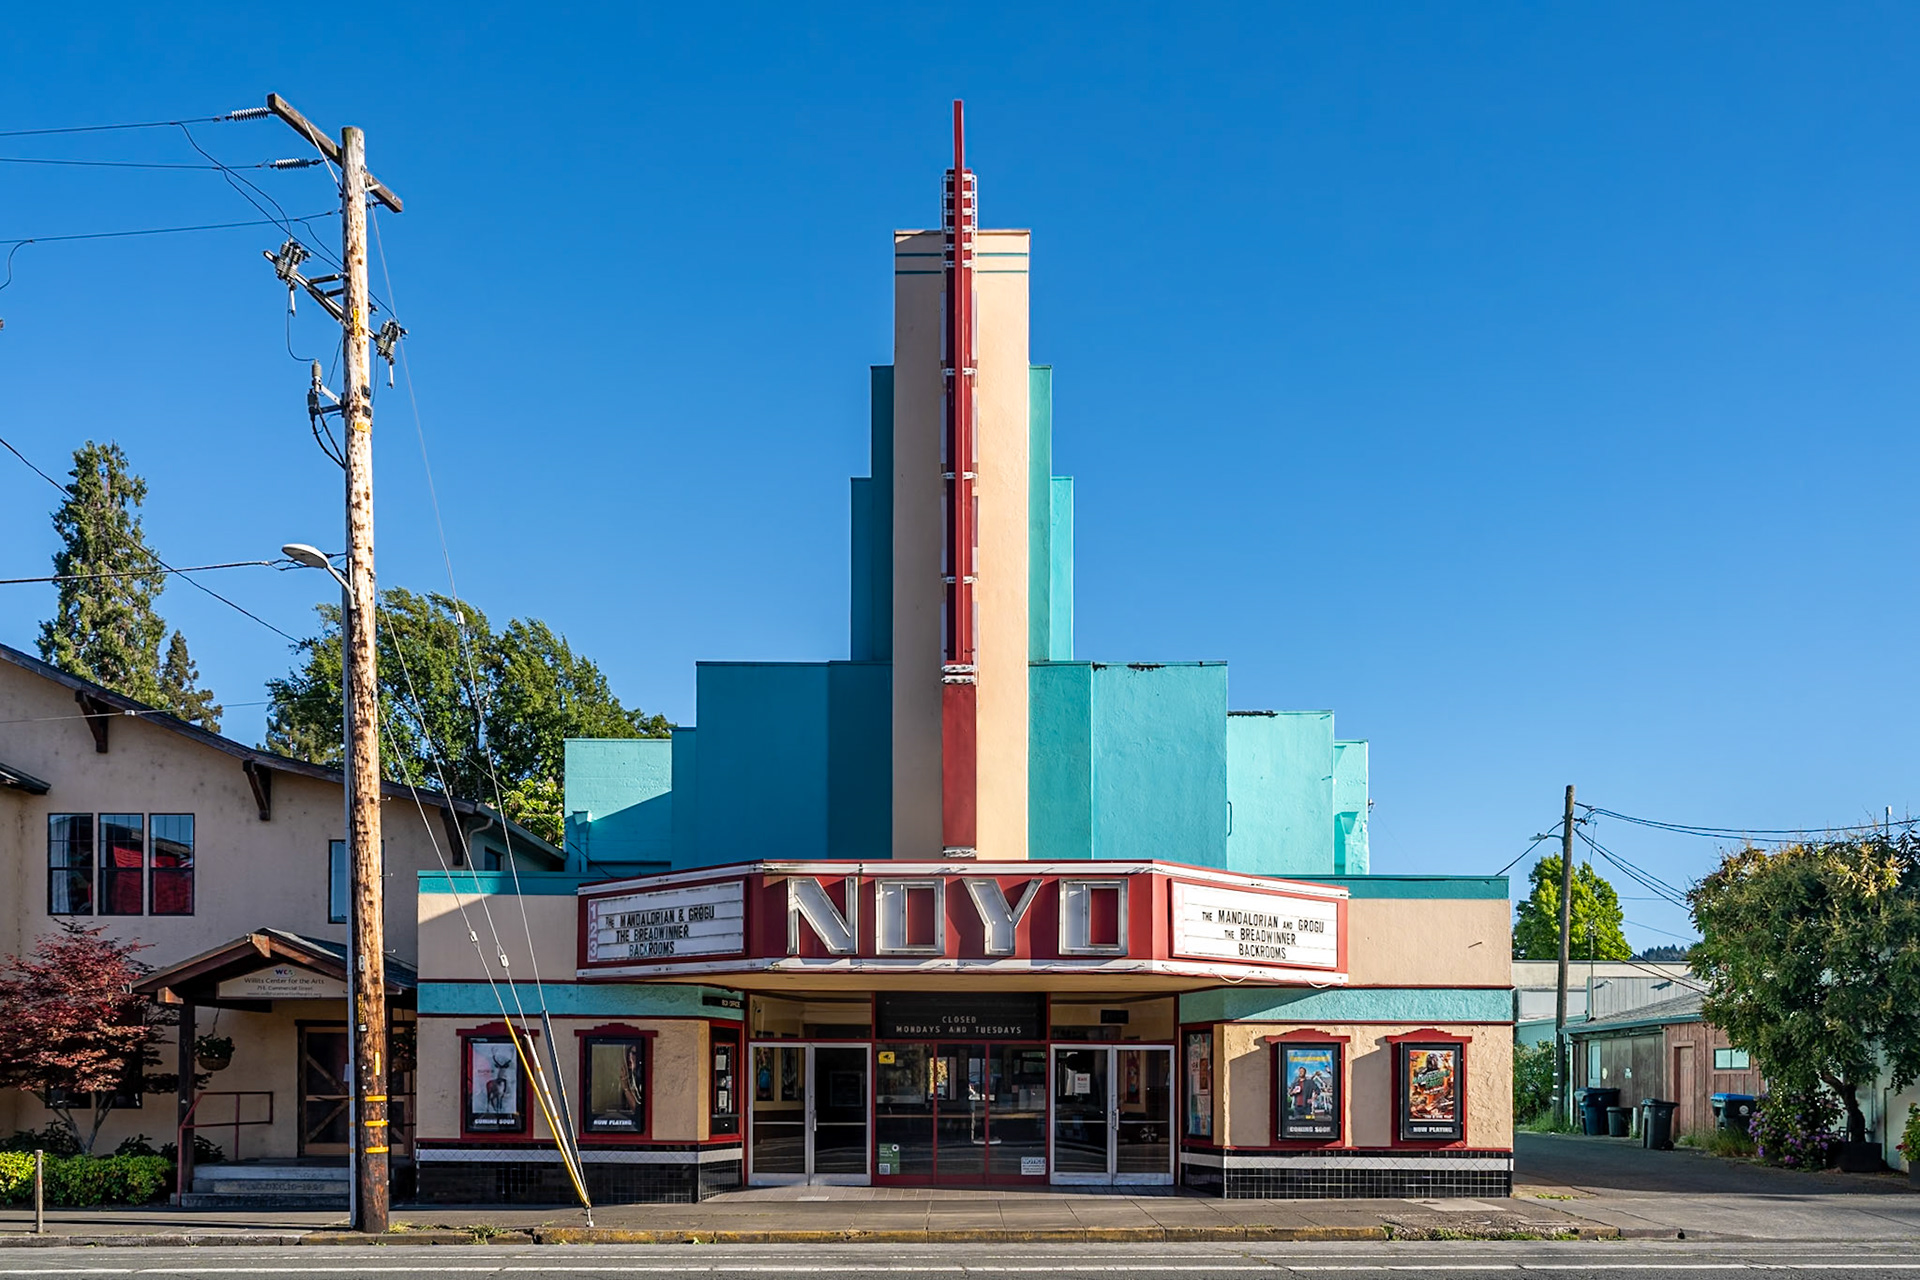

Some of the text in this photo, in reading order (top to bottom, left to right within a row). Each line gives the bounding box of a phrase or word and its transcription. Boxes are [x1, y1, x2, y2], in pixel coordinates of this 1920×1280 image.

[606, 906, 714, 928] THE MANDALORIAN & GROGU
[787, 876, 1130, 956] NOYO
[1202, 910, 1324, 934] THE MANDALORIAN AND GROGU
[590, 924, 598, 938] 2
[616, 924, 690, 943] THE BREADWINNER
[1224, 928, 1296, 946] THE BREADWINNER
[590, 942, 598, 956] 3
[629, 941, 675, 957] BACKROOMS
[1238, 944, 1286, 960] BACKROOMS
[942, 1016, 976, 1024] CLOSED
